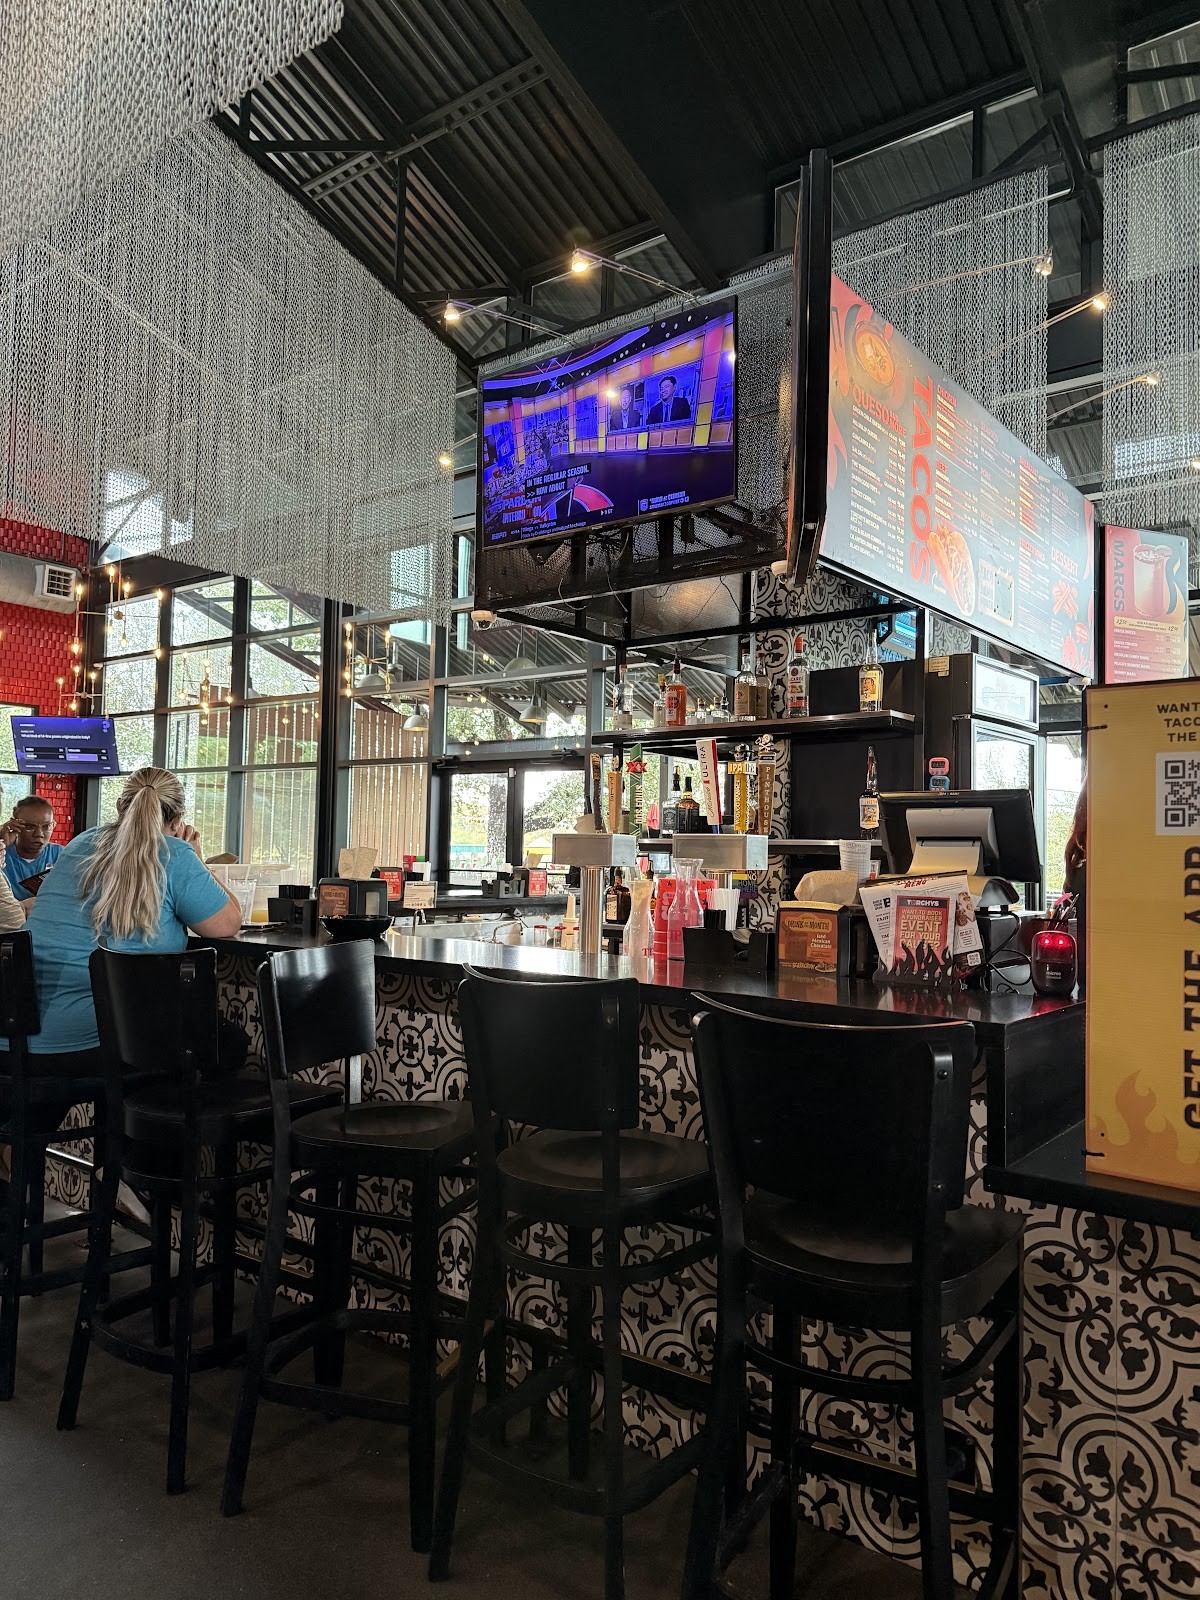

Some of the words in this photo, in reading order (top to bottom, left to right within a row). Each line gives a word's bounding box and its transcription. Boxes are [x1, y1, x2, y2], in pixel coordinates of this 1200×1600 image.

[853, 384, 889, 424] QUESO
[527, 479, 532, 487] IN
[534, 477, 542, 486] THE
[544, 471, 566, 483] REGULAR
[910, 375, 934, 585] TACOS
[536, 486, 548, 495] HOW
[549, 482, 565, 493] ABOUT
[492, 532, 507, 540] ESPN
[1052, 546, 1078, 577] DESSERT
[1113, 540, 1124, 612] MARGS
[1157, 702, 1200, 713] WANT
[1167, 732, 1197, 742] THE
[626, 762, 647, 773] XX
[700, 746, 708, 778] ULTRA
[730, 763, 743, 772] IPA
[788, 921, 804, 929] DRINK
[809, 921, 830, 930] MONTH
[900, 921, 941, 932] EVENT
[920, 932, 940, 940] YOUR
